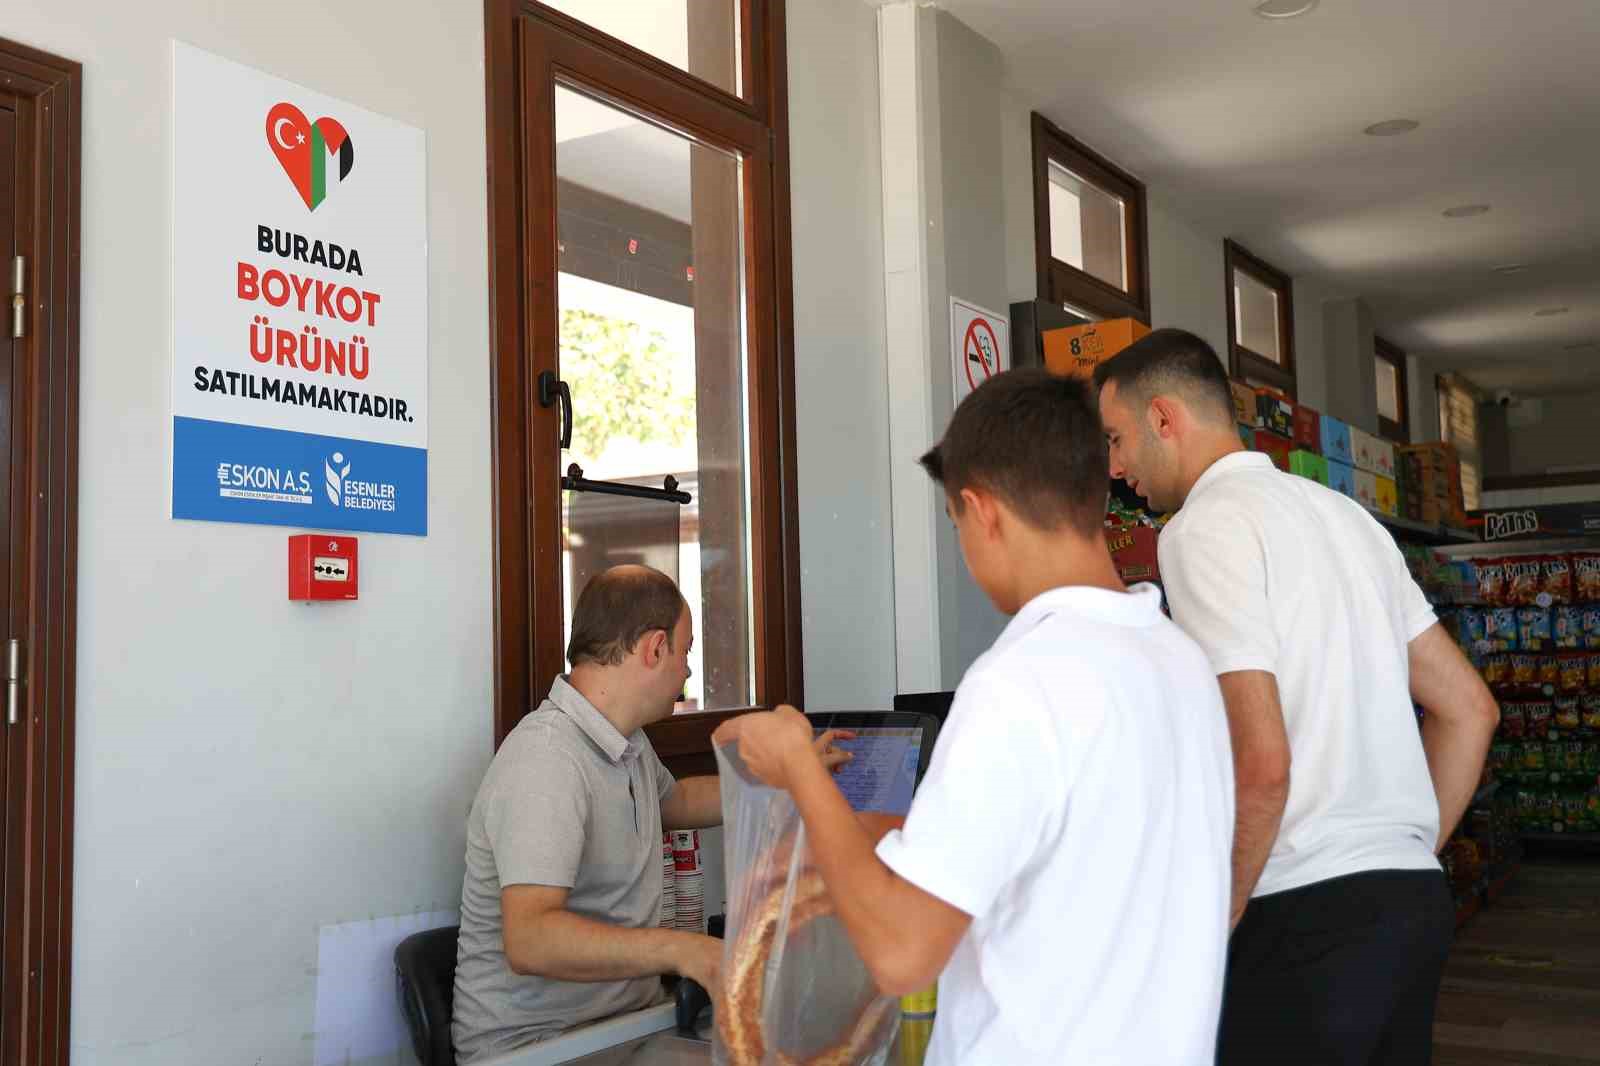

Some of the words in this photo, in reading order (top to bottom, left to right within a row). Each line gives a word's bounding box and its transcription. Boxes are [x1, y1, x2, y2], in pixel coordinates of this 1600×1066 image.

[257, 224, 363, 276] BURADA
[237, 261, 381, 327] BOYKOT
[249, 314, 369, 381] ÜRÜNÜ
[194, 365, 414, 423] SATILMAMAKTADIR.
[217, 462, 280, 490] ESKON
[344, 480, 395, 499] ESENLER
